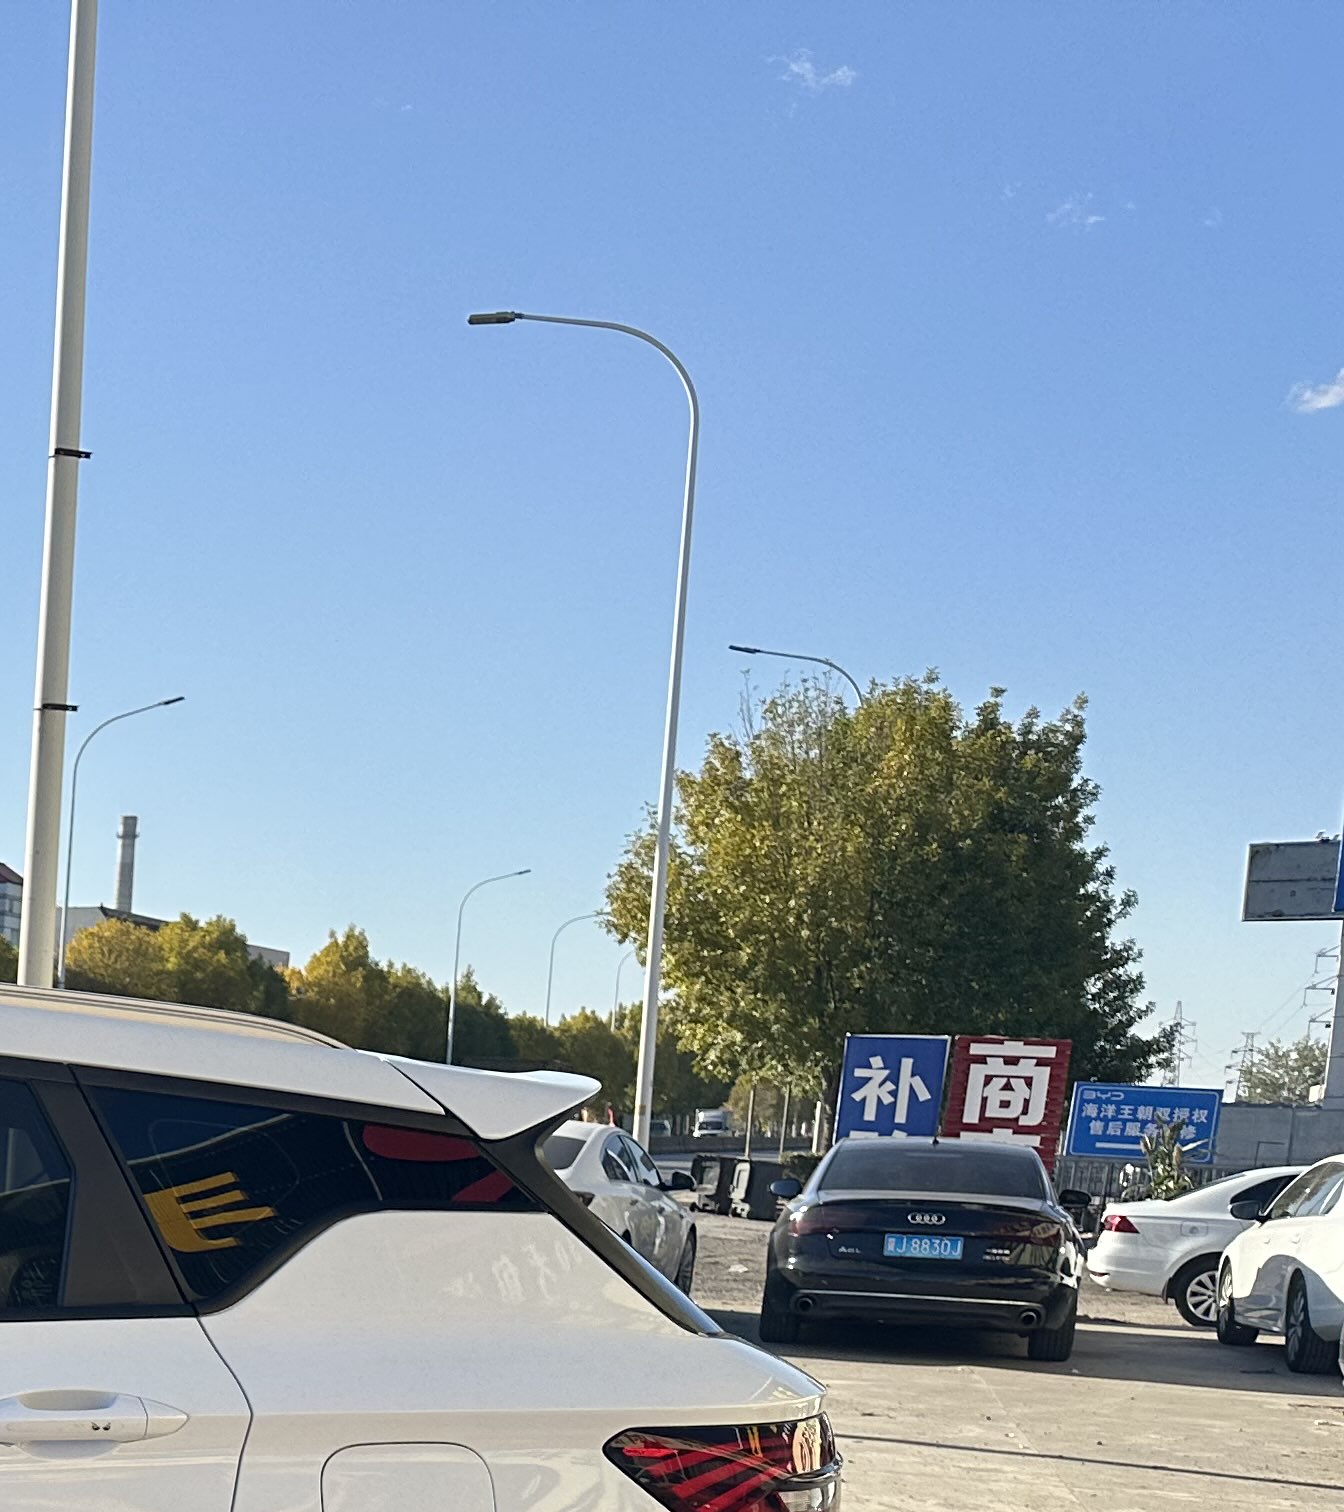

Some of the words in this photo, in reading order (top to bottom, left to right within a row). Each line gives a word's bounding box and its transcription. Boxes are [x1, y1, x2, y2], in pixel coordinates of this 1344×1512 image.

[851, 1056, 931, 1138] 补
[960, 1041, 1057, 1146] 商
[1082, 1090, 1125, 1100] BYD
[1081, 1102, 1209, 1124] 海洋王朝双授权
[1089, 1120, 1197, 1140] 售后服务修
